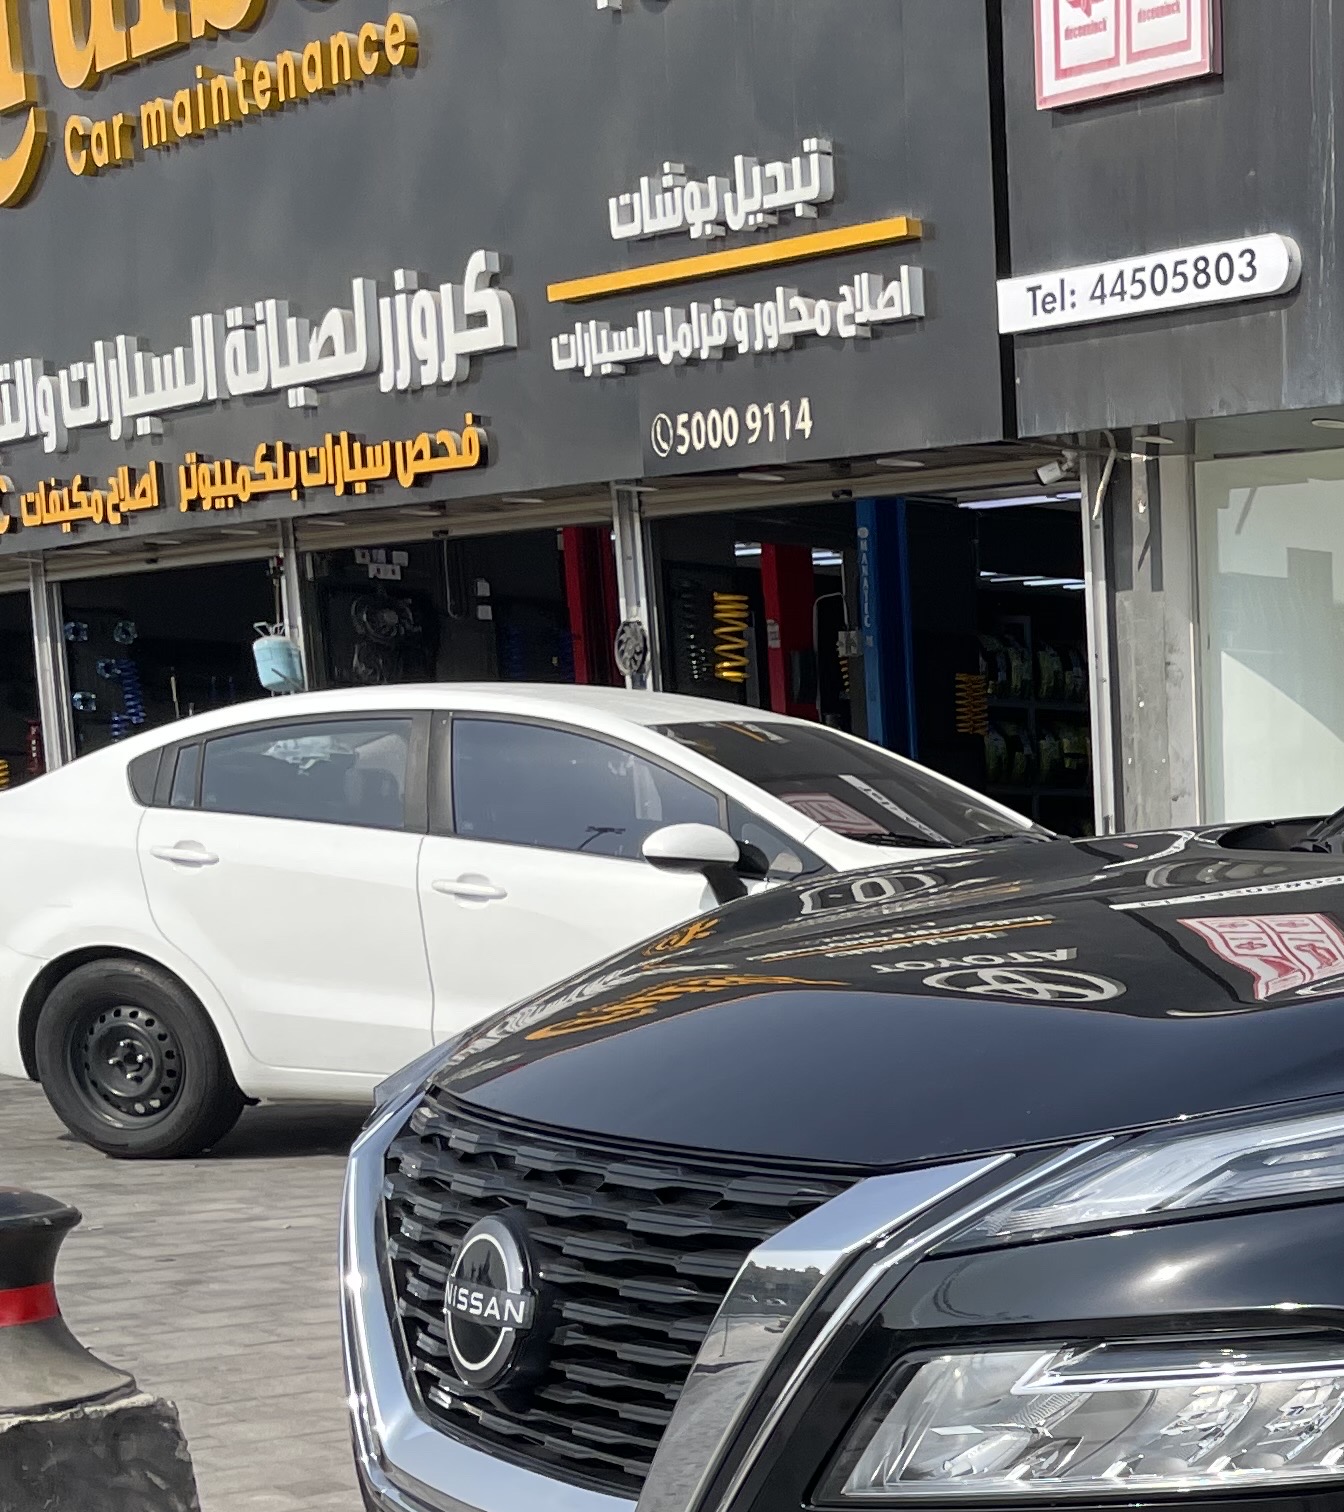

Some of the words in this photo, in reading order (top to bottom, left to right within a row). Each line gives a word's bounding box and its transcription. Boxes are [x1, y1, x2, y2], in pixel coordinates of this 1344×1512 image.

[64, 112, 130, 176] Car
[140, 12, 416, 150] maintenance
[608, 161, 728, 240] بوشات
[724, 137, 834, 231] تبديل
[837, 264, 925, 338] اصلاح
[1026, 278, 1077, 317] Tel:
[1089, 248, 1258, 306] 44505803
[225, 277, 375, 408] لصيانة
[379, 249, 516, 392] كروزر
[551, 309, 655, 377] السيارات
[657, 297, 732, 365] فرامل
[732, 305, 750, 354] و
[753, 286, 832, 351] محاور
[0, 357, 62, 453] والت
[58, 313, 224, 441] السيارات
[396, 411, 484, 488] فحص
[676, 407, 739, 455] 5000
[746, 396, 814, 445] 9114
[107, 460, 161, 525] اصلاح
[300, 430, 393, 496] سيارات
[20, 474, 105, 533] مكيفات
[445, 1280, 526, 1324] NISSAN
